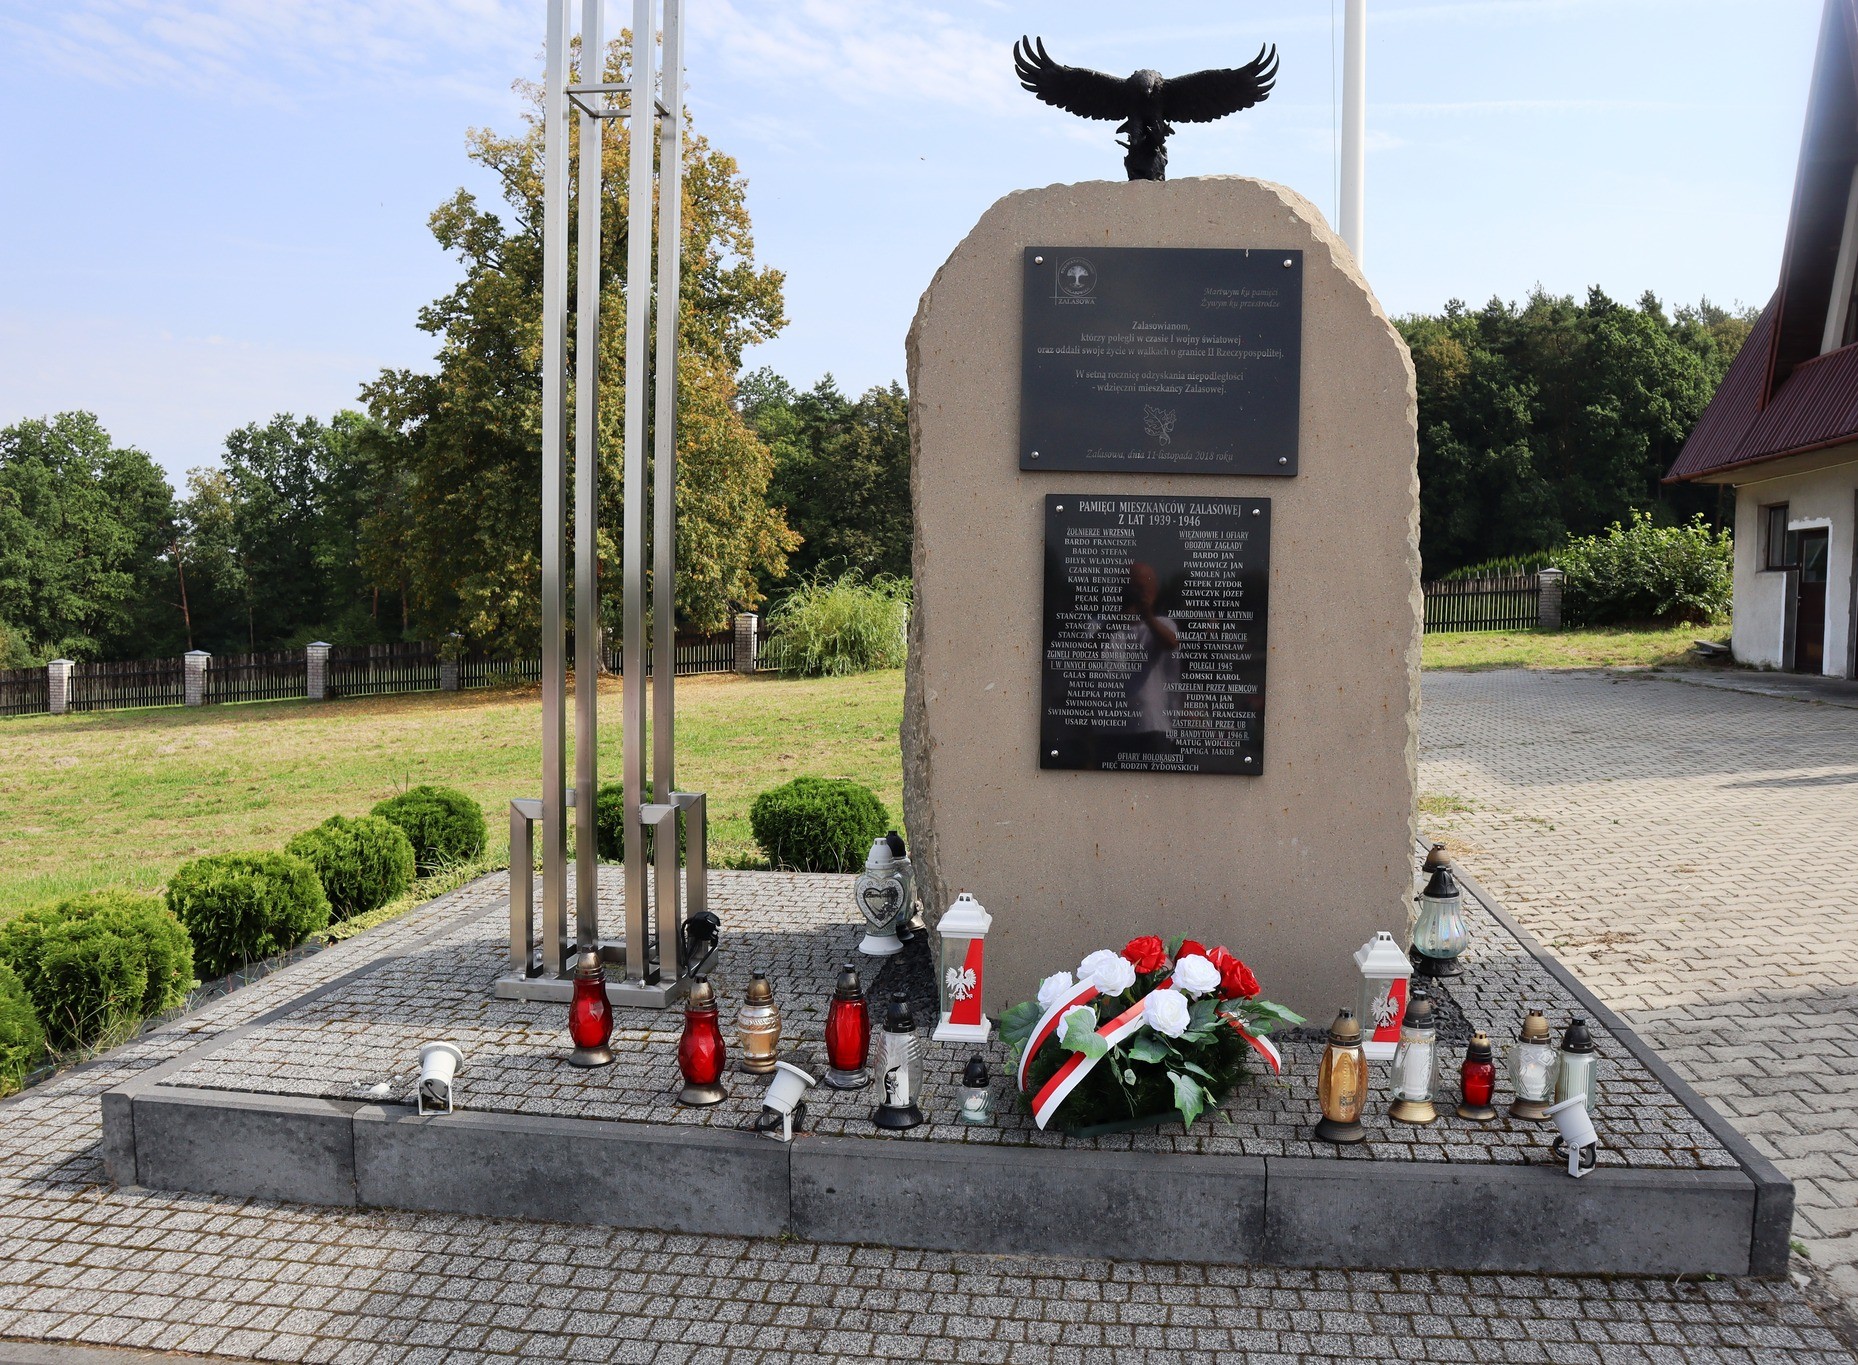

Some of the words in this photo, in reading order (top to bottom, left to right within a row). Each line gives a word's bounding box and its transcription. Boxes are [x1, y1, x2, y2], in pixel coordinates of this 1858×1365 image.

[1203, 288, 1239, 297] Martwym
[1240, 299, 1280, 310] przestrodze
[1081, 333, 1105, 344] którzy
[1108, 334, 1135, 344] polegli
[1145, 334, 1168, 342] czasie
[1175, 335, 1200, 346] wojny
[1056, 346, 1080, 354] oddali
[1082, 346, 1104, 356] swoje
[1106, 346, 1126, 356] życie
[1137, 347, 1168, 356] walkach
[1177, 348, 1205, 358] granice
[1075, 370, 1084, 378] W
[1086, 371, 1106, 380] setną
[1108, 371, 1139, 381] rocznicę
[1142, 371, 1185, 381] odzyskania
[1187, 372, 1244, 382] niepodległości
[1138, 384, 1183, 395] mieszkańcy
[1128, 450, 1145, 459] dnia
[1195, 450, 1214, 460] 2018
[1216, 451, 1233, 463] roku
[1079, 500, 1115, 515] PAMIĘCI
[1120, 500, 1186, 514] MIESZKAŃCÓW
[1189, 503, 1241, 517] ZALASOWEJ
[1118, 514, 1124, 525] Z
[1128, 514, 1145, 525] LAT
[1226, 531, 1249, 539] OFIARY
[1230, 562, 1243, 570] JAN
[1222, 571, 1236, 579] JAN
[1222, 589, 1244, 598] JÓZEF
[1075, 595, 1098, 603] PĘCAK
[1056, 612, 1092, 620] STAŃCZYK
[1097, 613, 1141, 621] FRANCISZEK
[1168, 610, 1215, 618] ZAMORDOWANY
[1227, 611, 1253, 619] KATYNIU
[1065, 621, 1101, 630] STAŃCZYK
[1222, 623, 1235, 631] JAN
[1100, 642, 1144, 650] FRANCISZEK
[1171, 651, 1208, 659] STAŃCZYK
[1055, 661, 1061, 669] W
[1064, 661, 1086, 669] INNYCH
[1218, 662, 1233, 670] 1945
[1163, 683, 1204, 691] ZASTRZELENI
[1206, 684, 1225, 692] PRZEZ
[1220, 694, 1232, 702] JAN
[1211, 702, 1234, 710] JAKUB
[1212, 711, 1256, 719] FRANCISZEK
[1091, 719, 1126, 727] WOJCIECH
[1172, 720, 1213, 728] ZASTRZELENI
[1215, 720, 1235, 728] PRZEZ
[1211, 748, 1235, 756] JAKUB
[1117, 752, 1139, 760] OFIARY
[1142, 753, 1184, 762] HOLOKAUSTU
